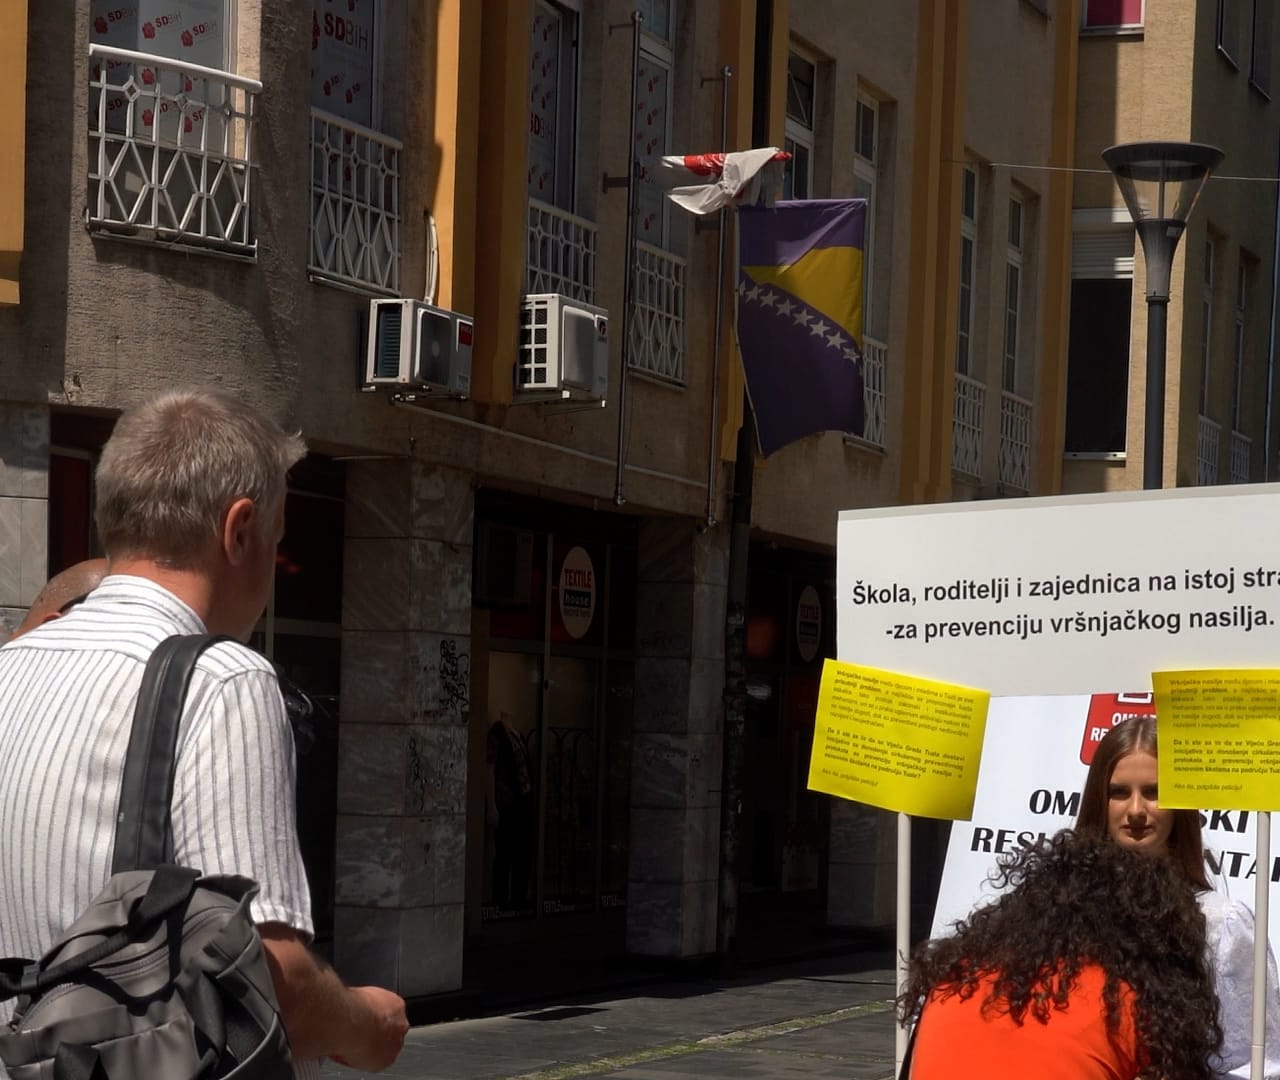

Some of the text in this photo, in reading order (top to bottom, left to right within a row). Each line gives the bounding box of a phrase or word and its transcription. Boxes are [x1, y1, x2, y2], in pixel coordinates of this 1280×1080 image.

[324, 12, 369, 51] SDBiH
[563, 567, 593, 590] TEXTILE
[852, 580, 917, 606] Škola,
[924, 577, 1010, 604] roditelji
[1017, 577, 1023, 597] i
[1029, 572, 1141, 602] zajednica
[1148, 574, 1177, 592] na
[1185, 568, 1236, 593] istoj
[886, 605, 1276, 643] -za prevenciju vršnjačkog nasilja.
